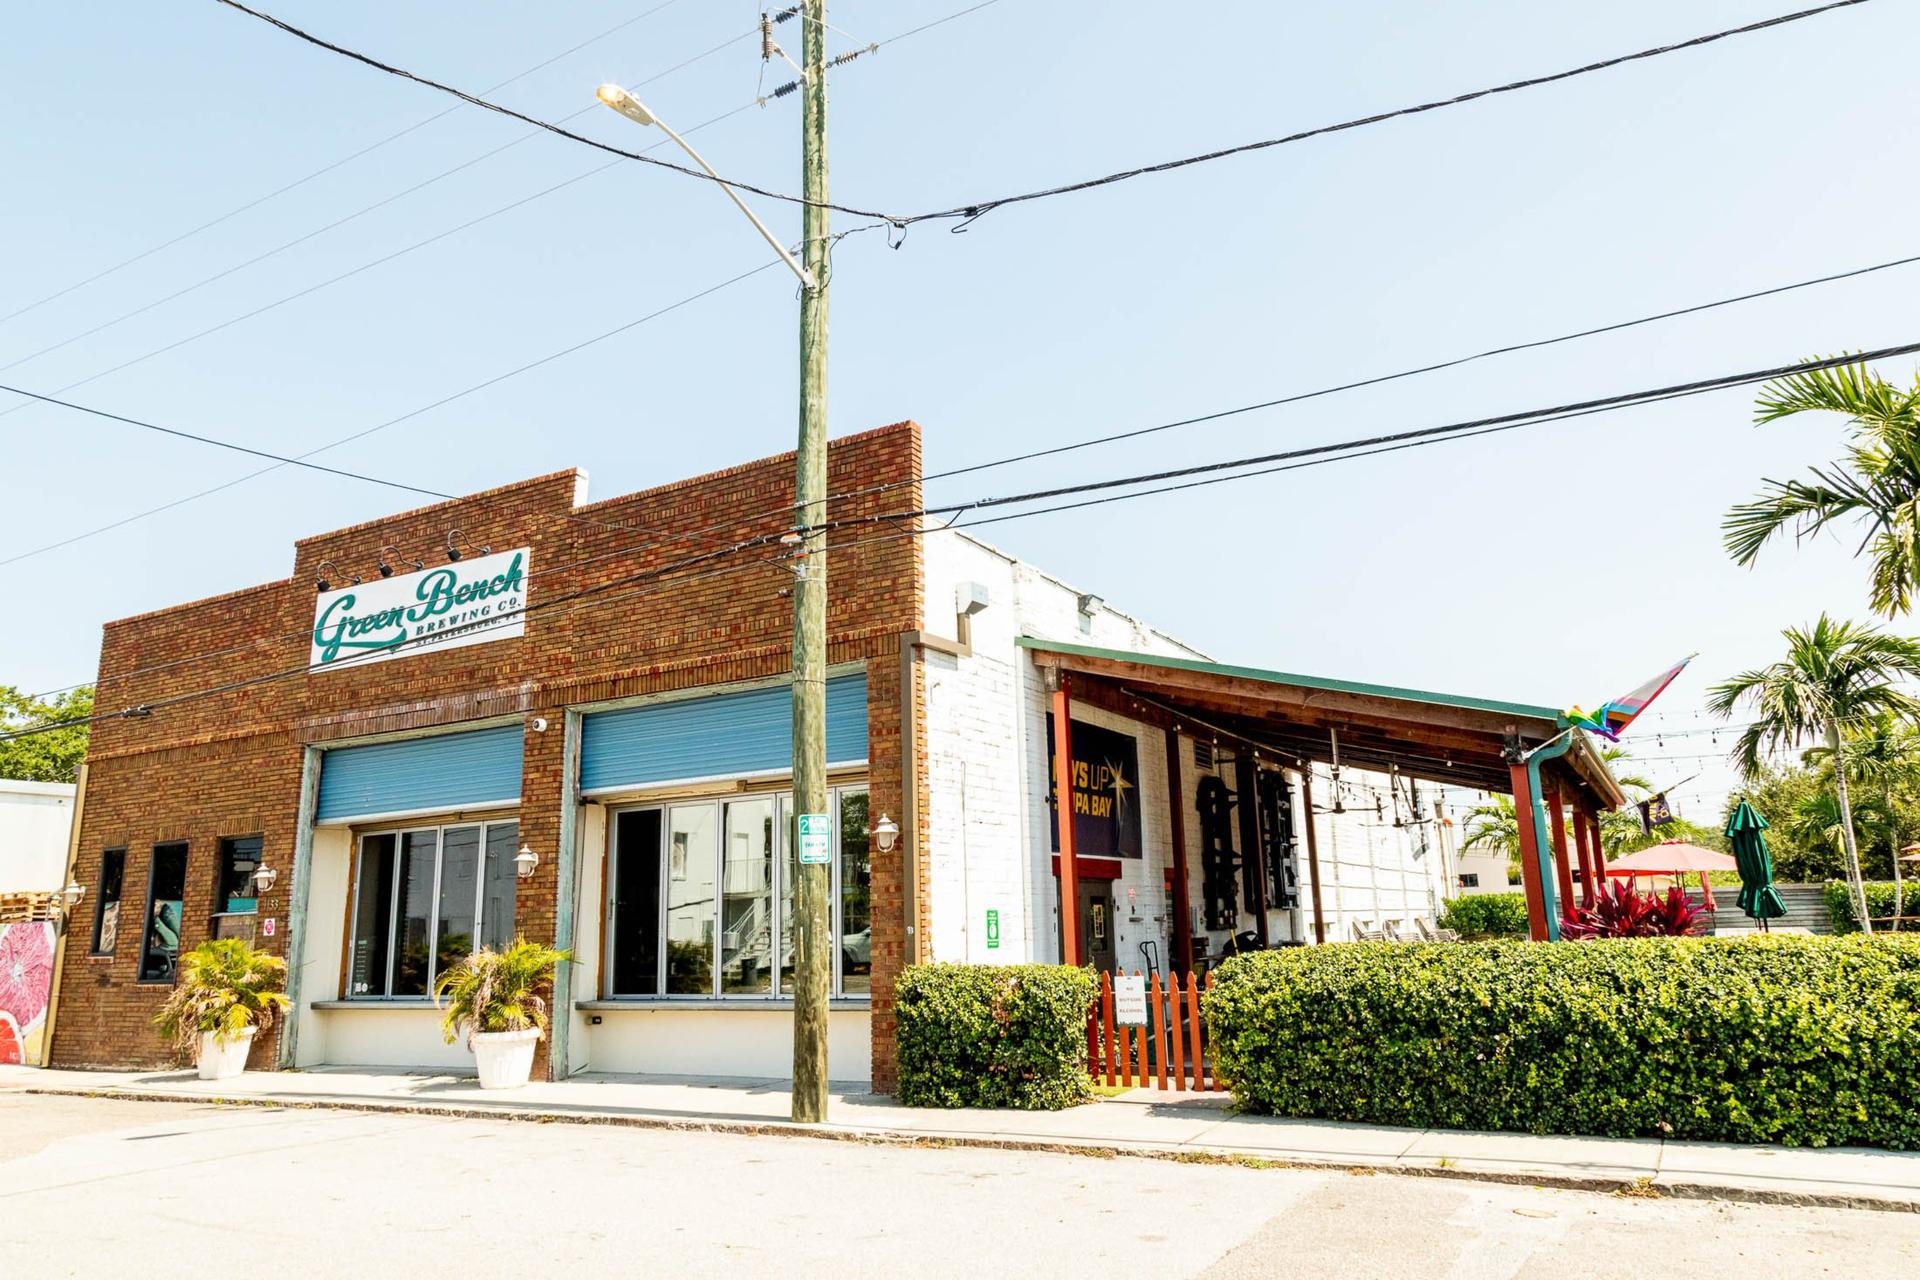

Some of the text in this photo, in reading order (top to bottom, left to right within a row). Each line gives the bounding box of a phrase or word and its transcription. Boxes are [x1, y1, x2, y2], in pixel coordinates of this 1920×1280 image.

[314, 552, 523, 662] Green Bench
[416, 605, 491, 636] BREWING
[1090, 763, 1109, 791] UP
[1092, 795, 1112, 817] BAY
[801, 820, 809, 833] 2
